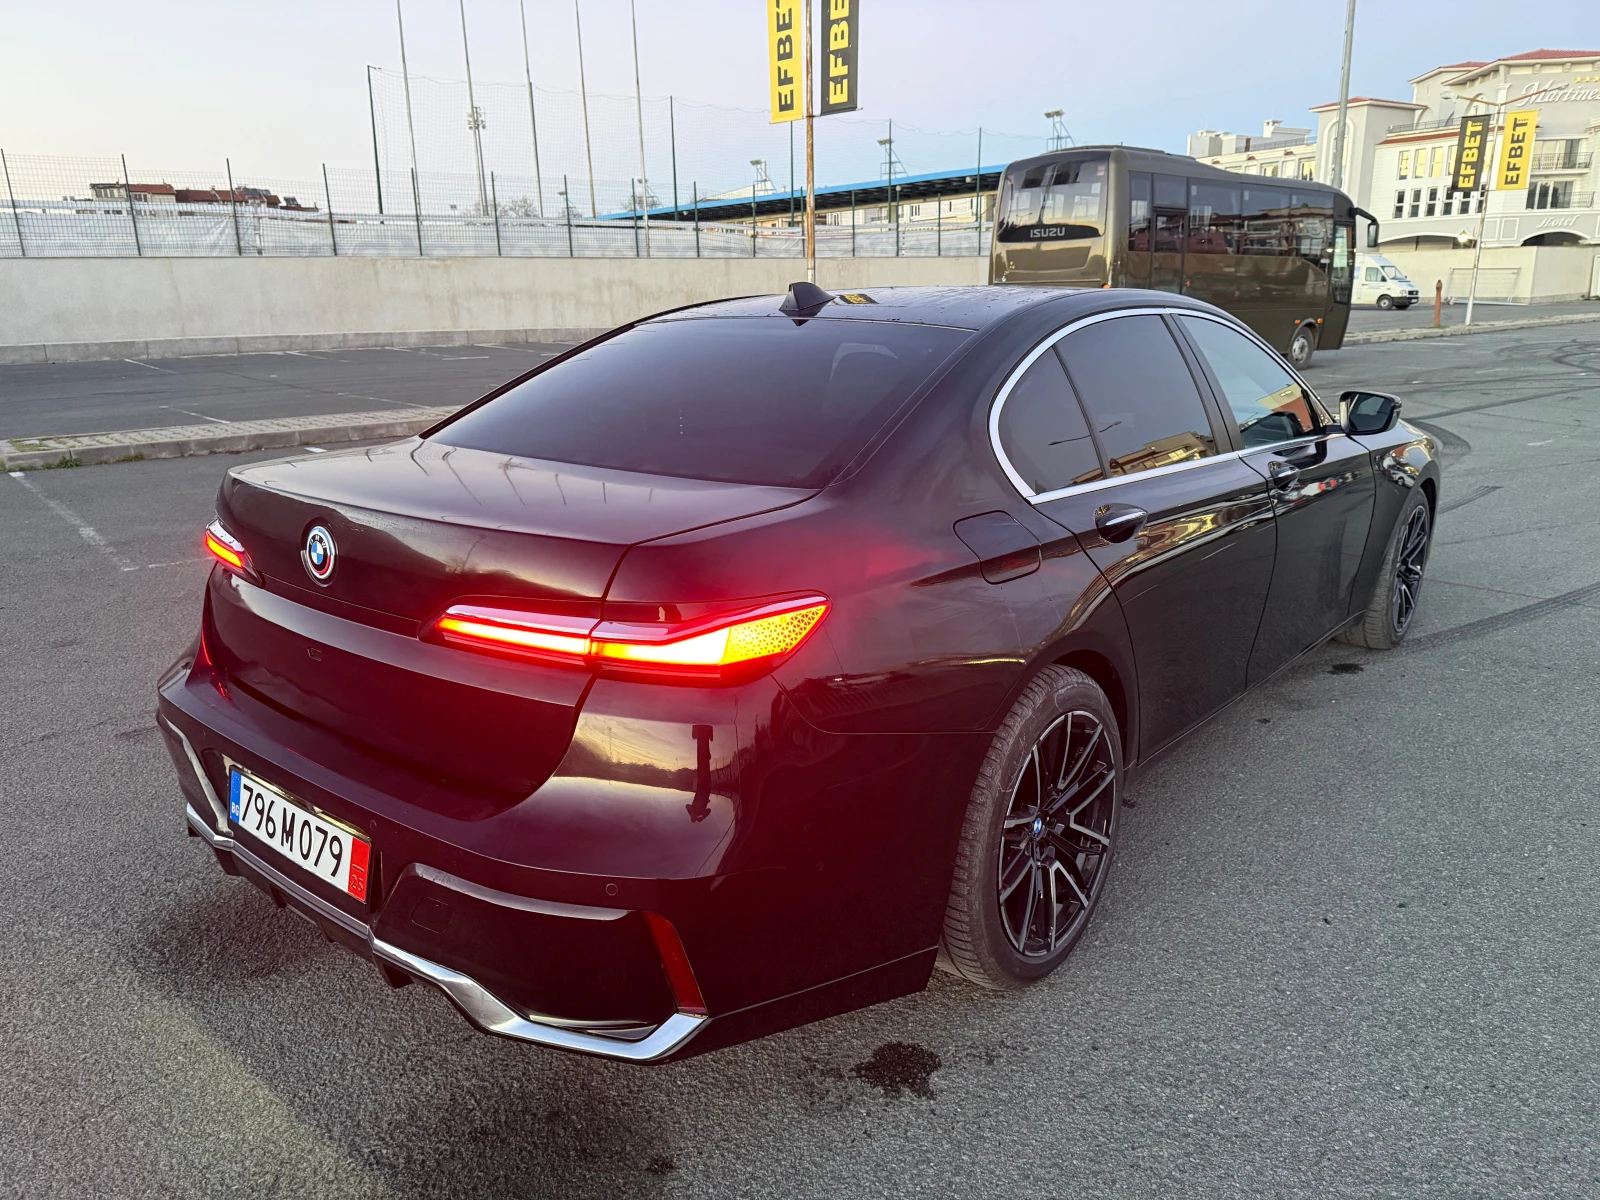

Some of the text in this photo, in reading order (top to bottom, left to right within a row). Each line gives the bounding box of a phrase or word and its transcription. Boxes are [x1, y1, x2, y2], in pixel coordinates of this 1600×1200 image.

[1458, 121, 1483, 188] EFBET
[1504, 117, 1528, 185] EFBET
[1030, 227, 1065, 238] ISUZU
[1536, 214, 1580, 229] Hotel
[231, 801, 240, 816] BG
[241, 784, 343, 877] 796M079
